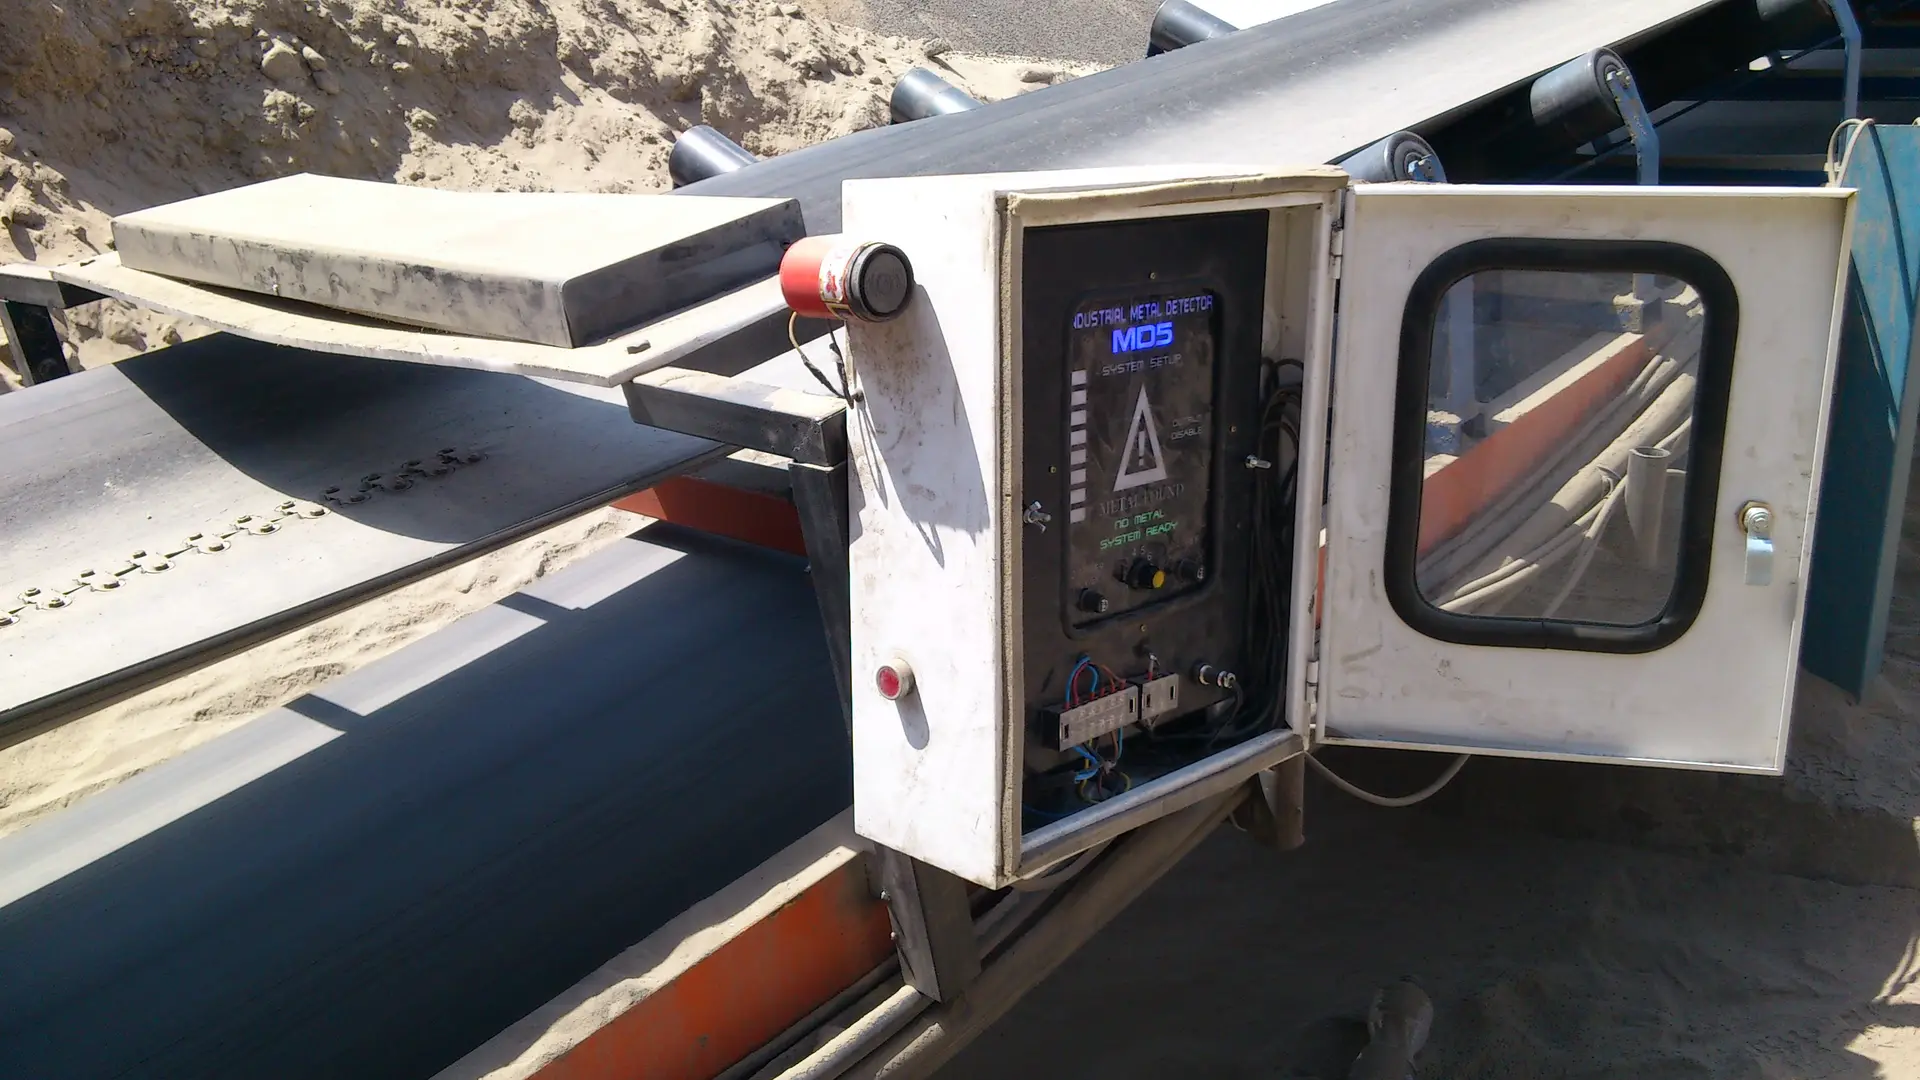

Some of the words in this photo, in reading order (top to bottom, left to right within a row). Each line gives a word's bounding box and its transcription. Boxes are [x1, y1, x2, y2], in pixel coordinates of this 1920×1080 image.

[1130, 302, 1163, 321] METAL
[1166, 295, 1213, 315] DETECTOR
[1112, 322, 1174, 354] MD5
[1102, 360, 1144, 376] SYSTEM
[1150, 353, 1183, 368] SETUP
[1171, 426, 1202, 440] DISABLE
[1099, 496, 1139, 516] METAL
[1143, 484, 1184, 505] FOUND
[1114, 517, 1129, 530] NO
[1134, 510, 1165, 525] METAL
[1100, 531, 1141, 550] SYSTEM
[1146, 521, 1179, 536] READY
